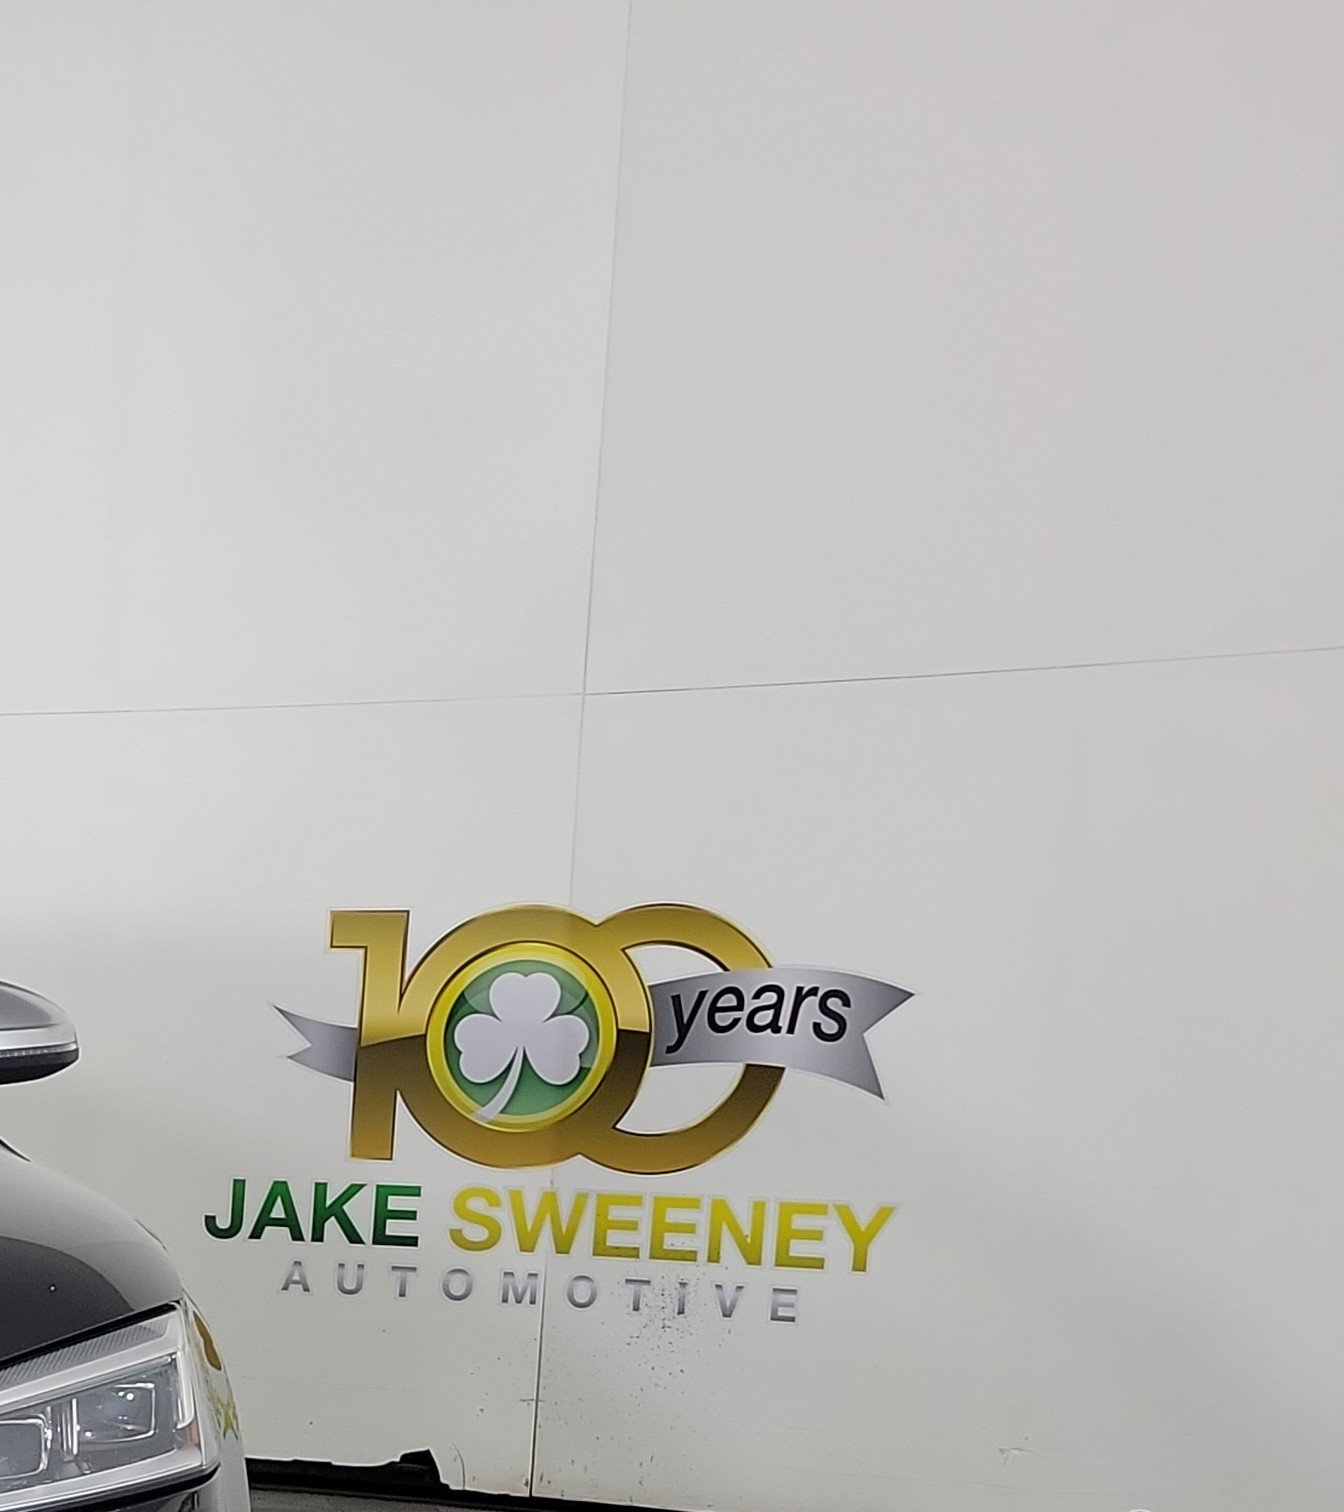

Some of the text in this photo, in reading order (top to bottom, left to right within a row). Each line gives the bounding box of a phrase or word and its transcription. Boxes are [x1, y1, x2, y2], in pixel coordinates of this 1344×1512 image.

[665, 982, 852, 1055] years
[203, 1178, 897, 1273] JAKE SWEENEY
[280, 1260, 799, 1324] AUTOMOTIVE
